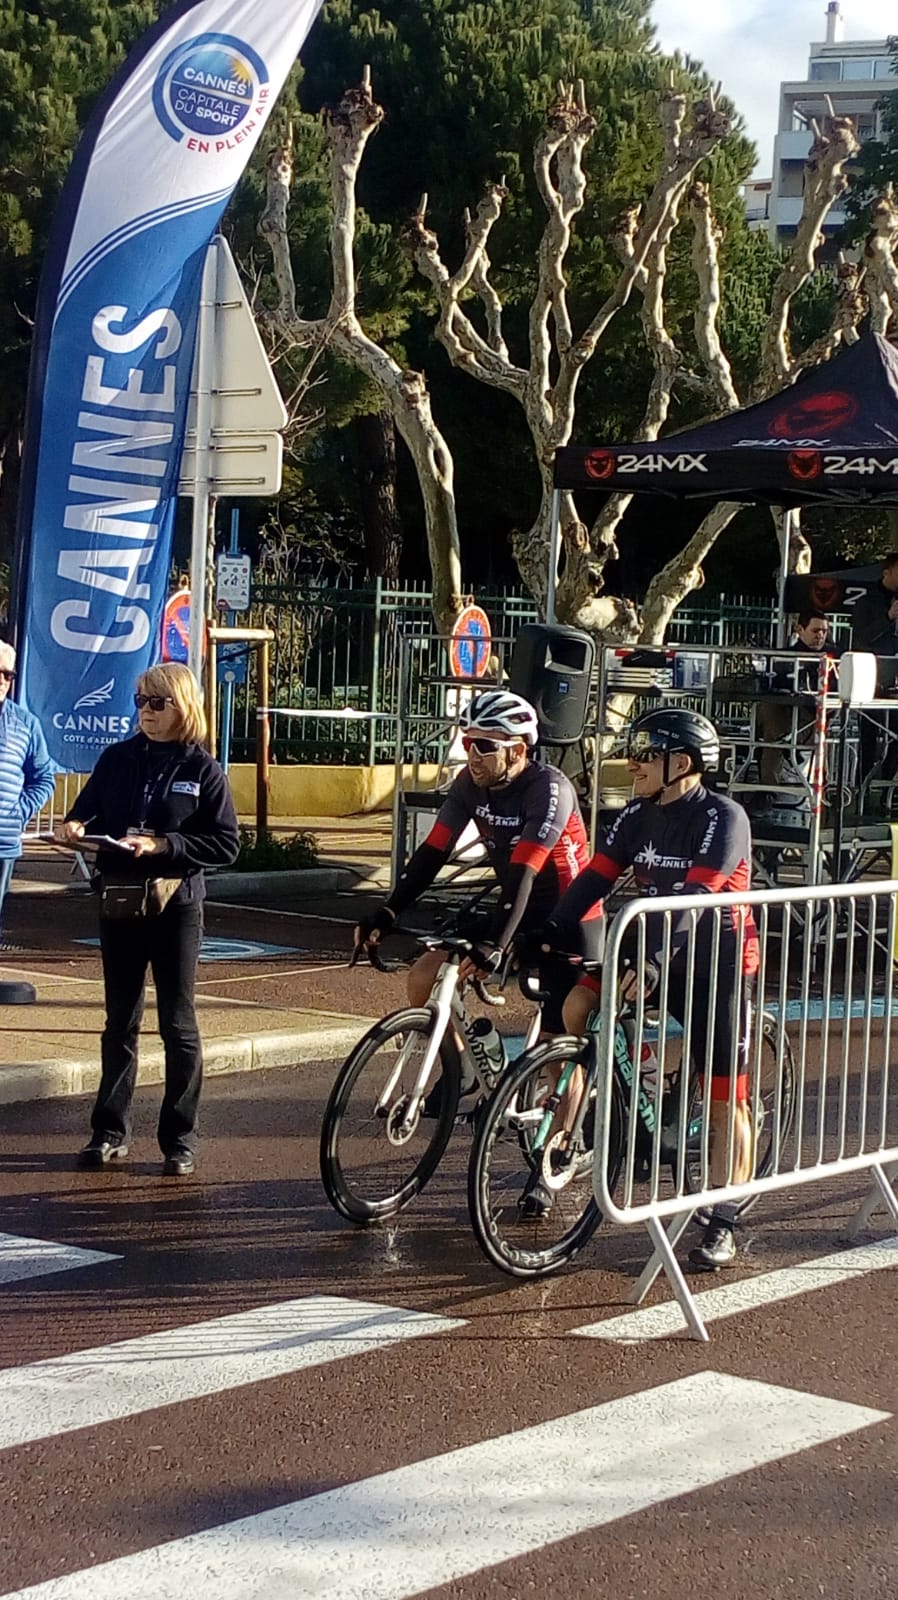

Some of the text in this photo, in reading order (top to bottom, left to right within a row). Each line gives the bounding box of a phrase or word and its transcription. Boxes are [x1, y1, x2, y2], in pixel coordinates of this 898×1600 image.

[183, 67, 247, 96] CANNES
[174, 100, 239, 127] DU SPORT
[178, 88, 241, 116] CAPITALE
[187, 88, 270, 153] EN PLEIN AIR
[617, 453, 709, 473] 24MX
[50, 304, 183, 654] CANNES
[52, 712, 131, 734] CANNES
[538, 797, 559, 839] CANNES
